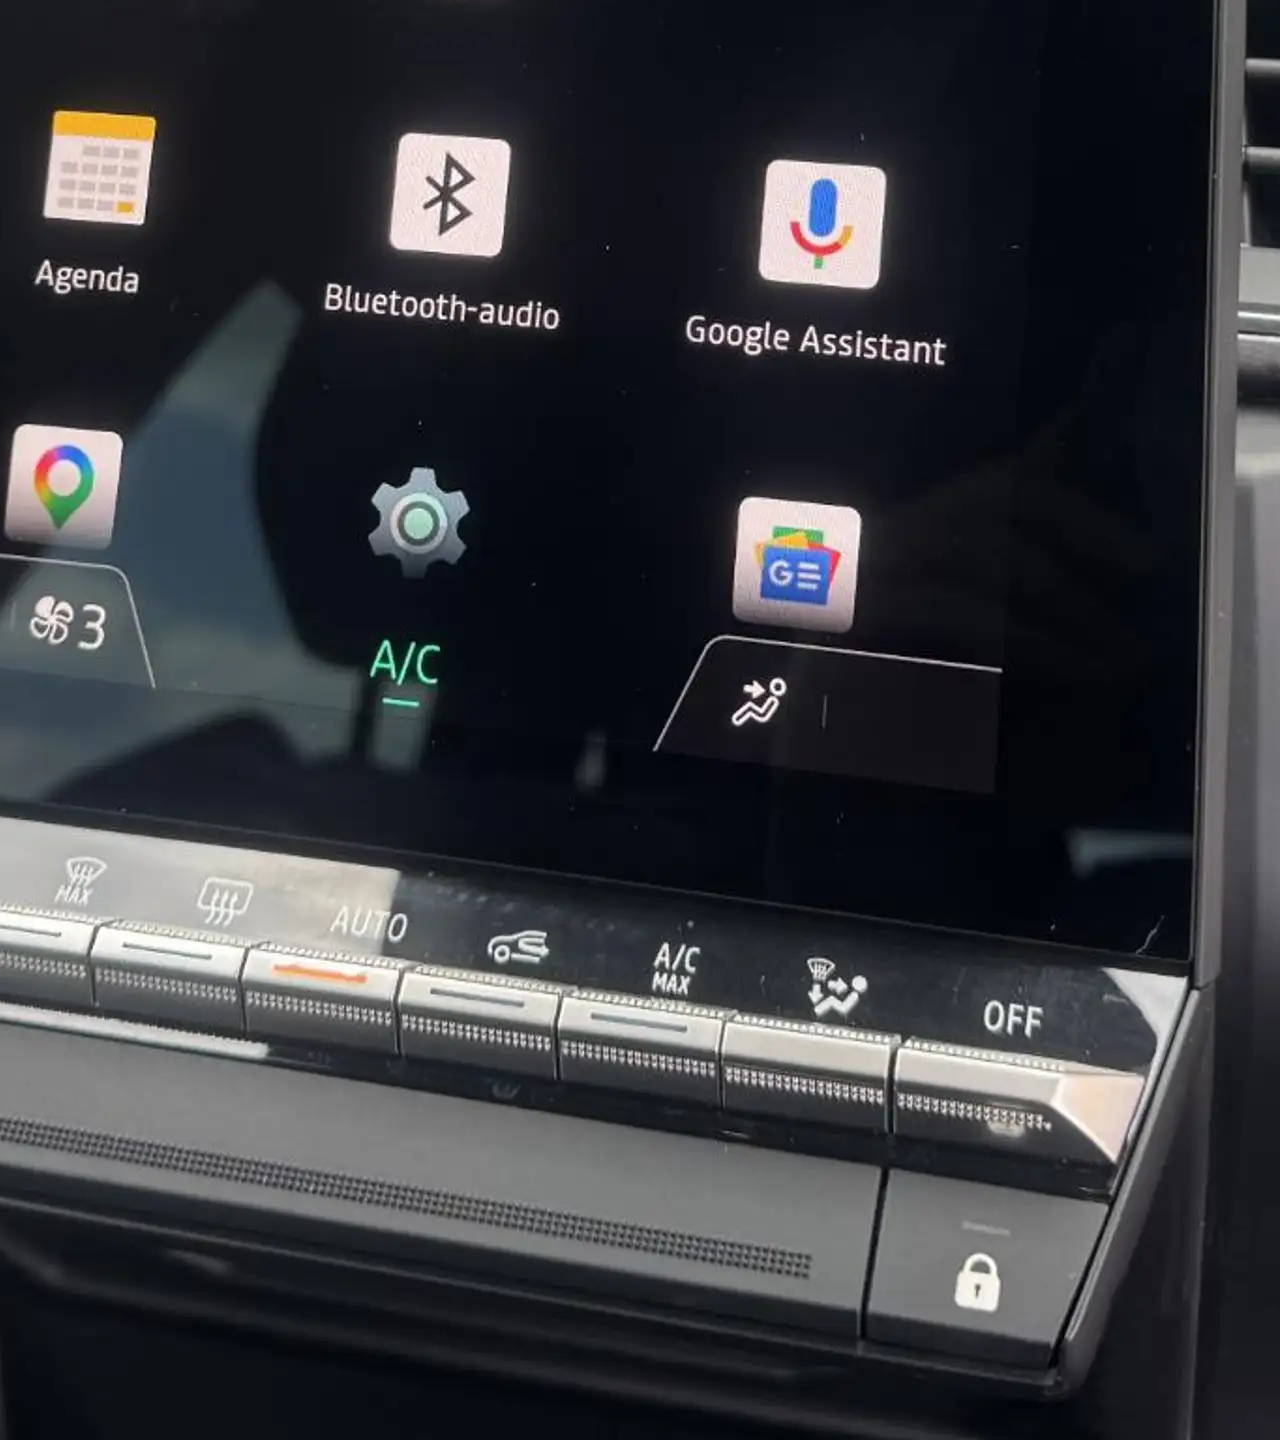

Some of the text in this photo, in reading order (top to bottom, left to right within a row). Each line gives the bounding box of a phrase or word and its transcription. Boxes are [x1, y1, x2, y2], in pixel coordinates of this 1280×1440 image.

[35, 259, 140, 295] Agenda
[324, 283, 561, 331] Bluetooth-audio
[686, 315, 948, 367] Google Assistant
[76, 603, 106, 650] 3
[369, 640, 442, 686] A/C
[53, 884, 95, 908] MAX
[329, 904, 409, 944] AUTO
[651, 942, 701, 975] A/C
[651, 971, 692, 997] MAX
[983, 999, 1045, 1039] OFF
